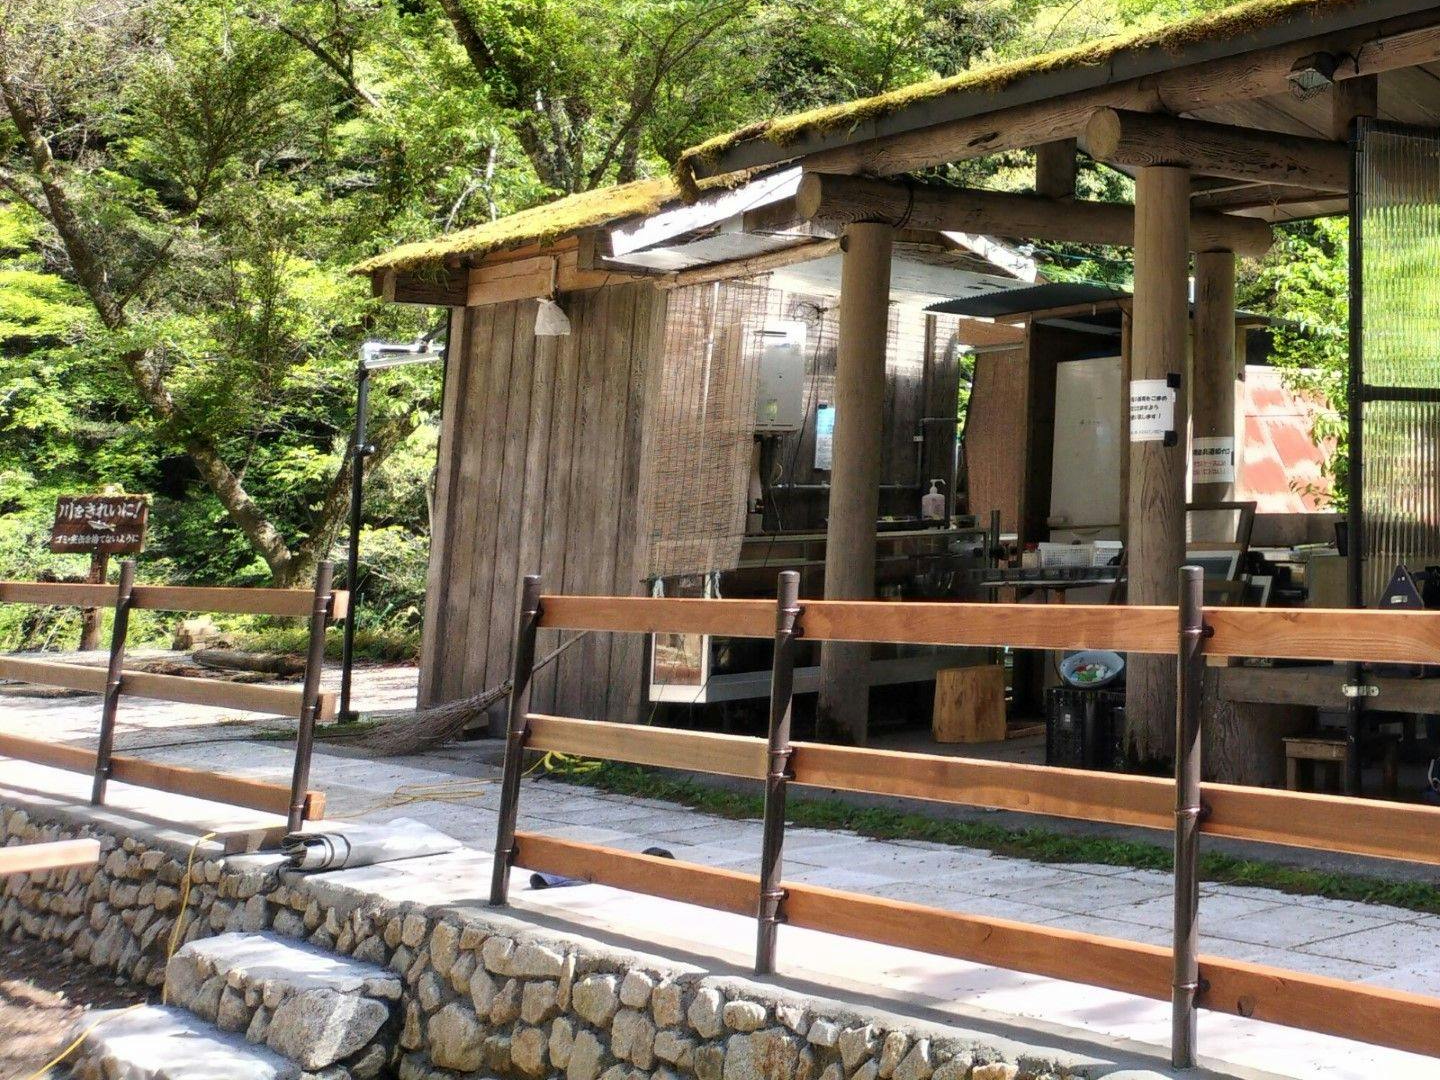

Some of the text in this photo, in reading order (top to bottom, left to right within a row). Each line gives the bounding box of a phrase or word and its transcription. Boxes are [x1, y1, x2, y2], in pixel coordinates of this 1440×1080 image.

[58, 501, 142, 520] 川をきれいに!
